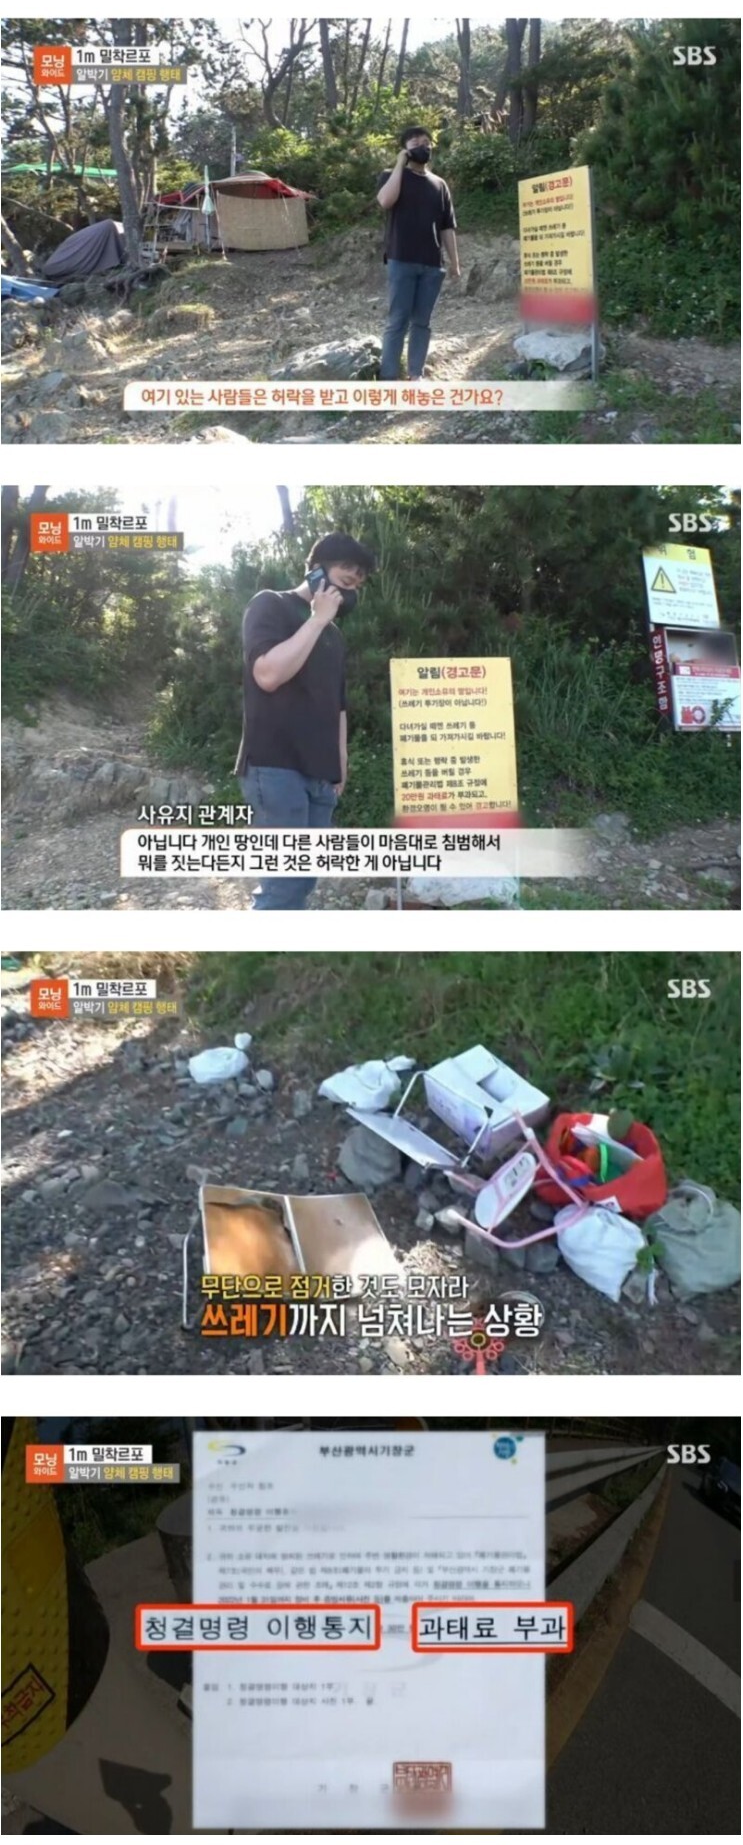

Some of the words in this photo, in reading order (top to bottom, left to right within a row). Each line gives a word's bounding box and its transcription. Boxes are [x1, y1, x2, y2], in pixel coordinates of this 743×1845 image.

[417, 666, 486, 679] 알림(경고문)
[145, 1614, 248, 1642] 청결명령
[267, 1614, 372, 1642] 이행통지
[418, 1614, 498, 1640] 과태료
[514, 1614, 566, 1640] 부과
